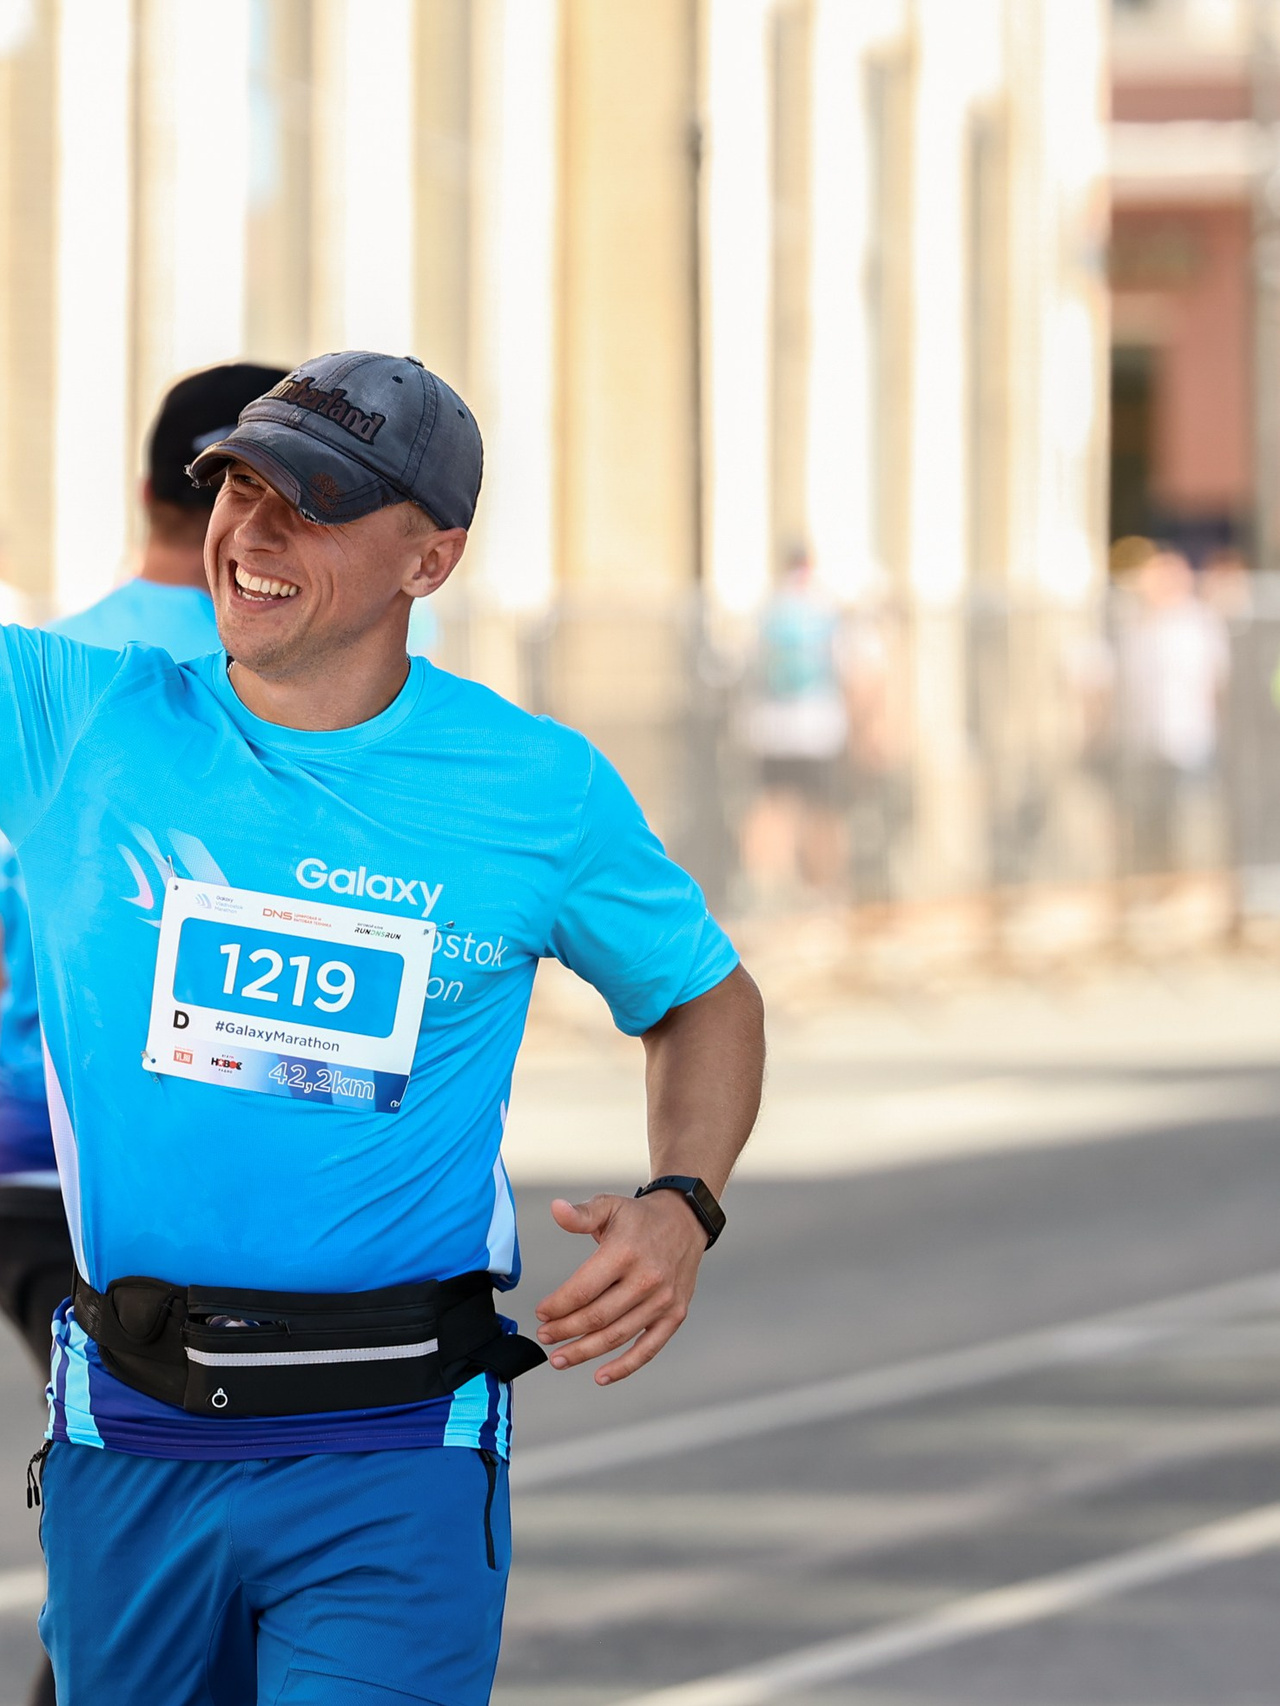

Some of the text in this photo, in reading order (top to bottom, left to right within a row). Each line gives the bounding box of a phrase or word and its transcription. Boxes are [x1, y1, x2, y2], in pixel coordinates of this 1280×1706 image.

[295, 858, 443, 917] Galaxy
[262, 907, 293, 921] DNS
[219, 943, 356, 1013] 1219
[173, 1009, 190, 1030] D
[215, 1020, 340, 1053] #GalaxyMarathon
[268, 1061, 375, 1100] 42,2km
